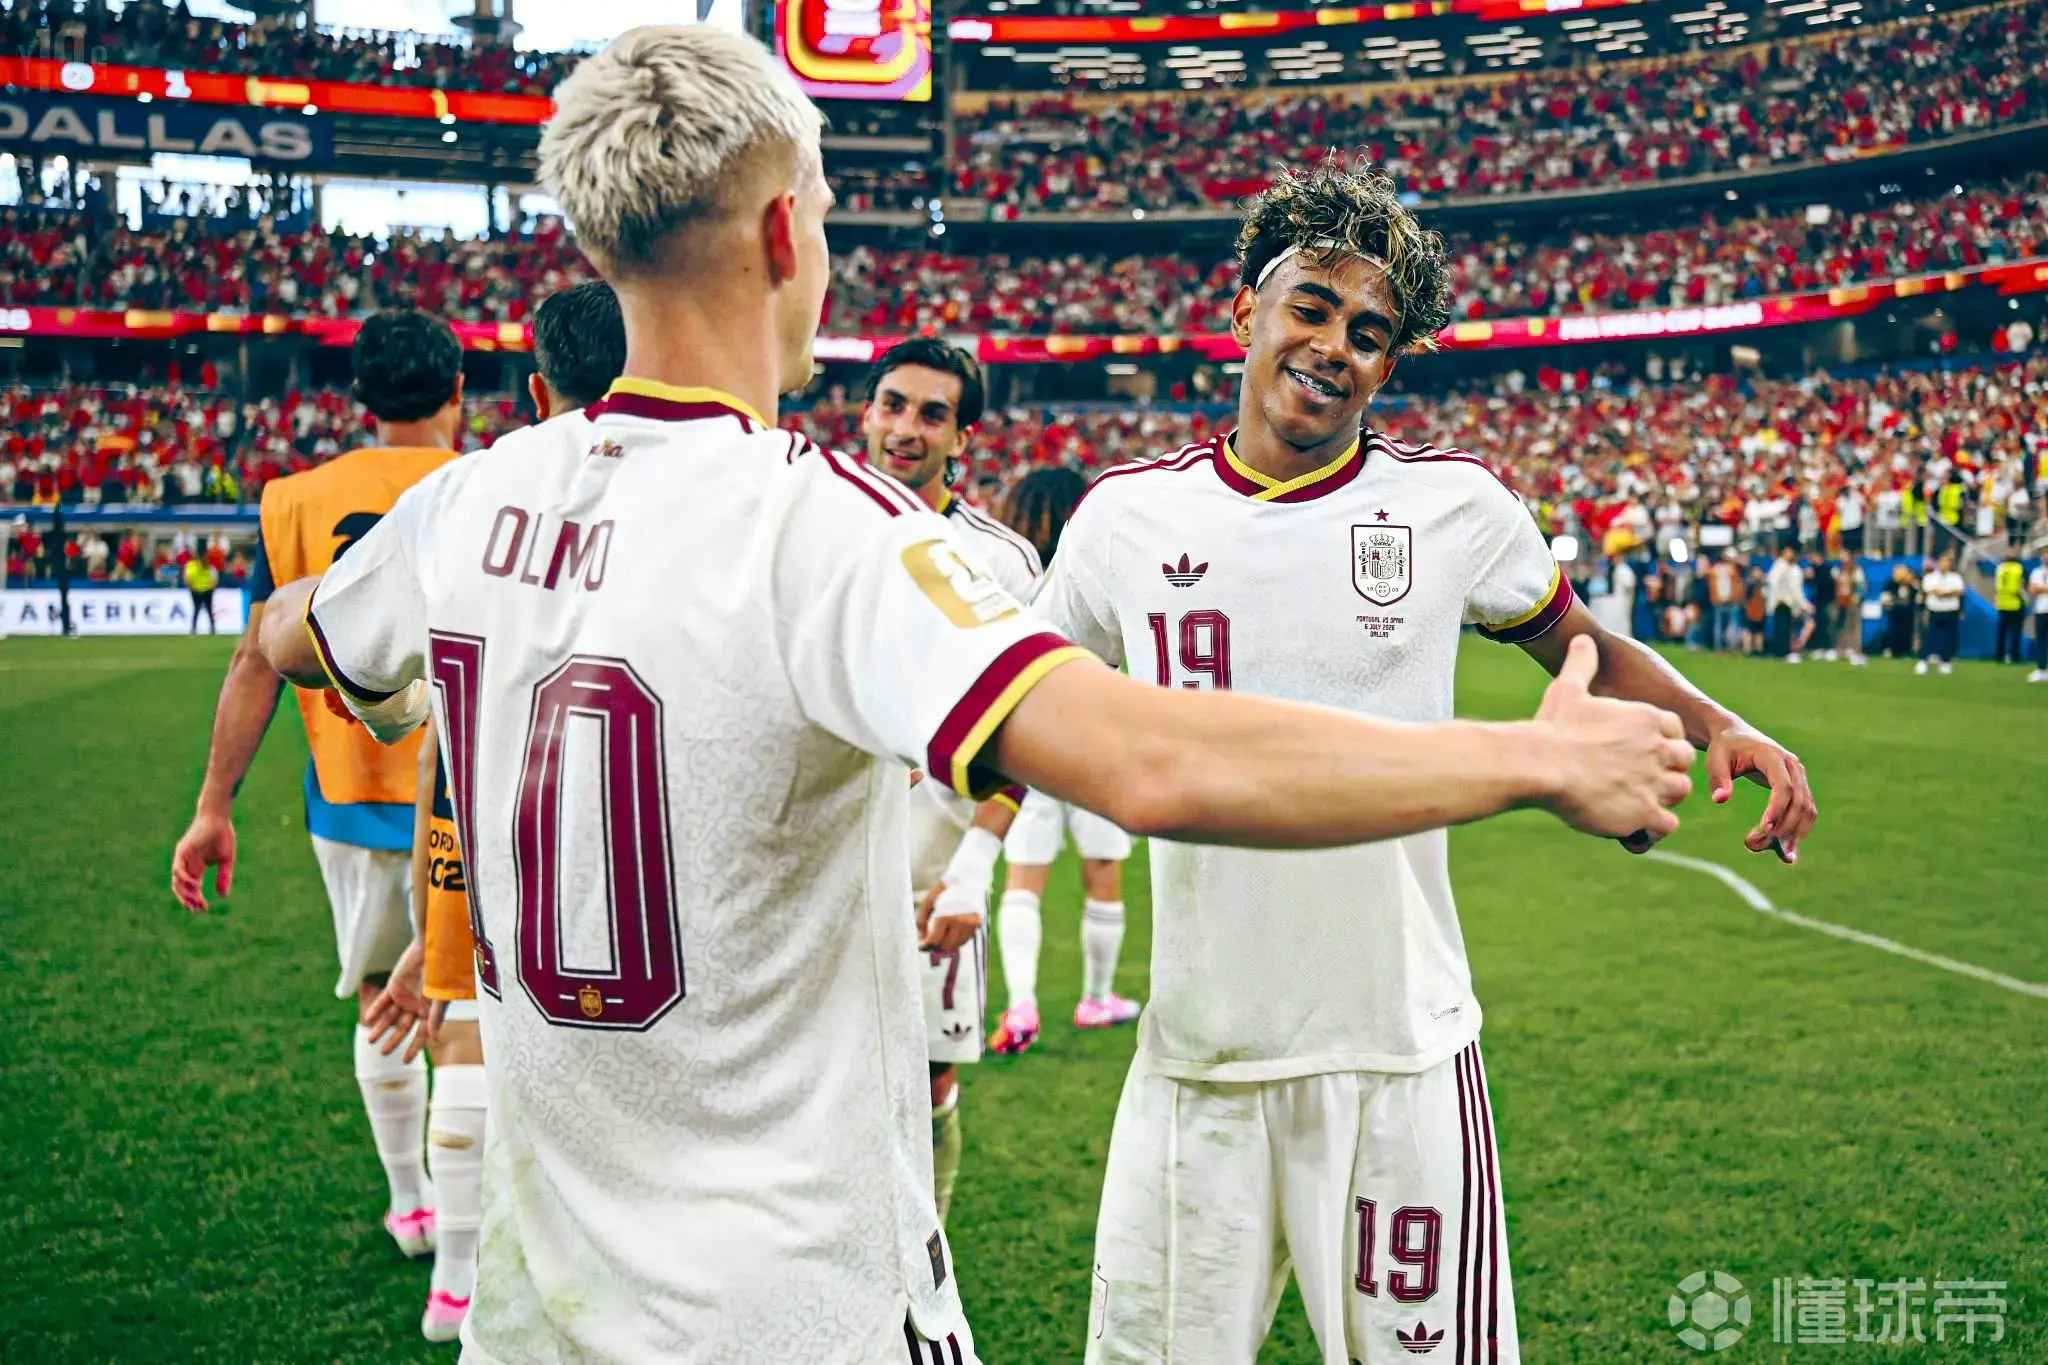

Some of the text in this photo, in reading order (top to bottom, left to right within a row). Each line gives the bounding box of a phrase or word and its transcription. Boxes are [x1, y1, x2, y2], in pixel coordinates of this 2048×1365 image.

[482, 505, 616, 593] OLMO
[1148, 609, 1232, 691] 19
[430, 628, 686, 1032] 10
[1355, 1195, 1443, 1304] 19
